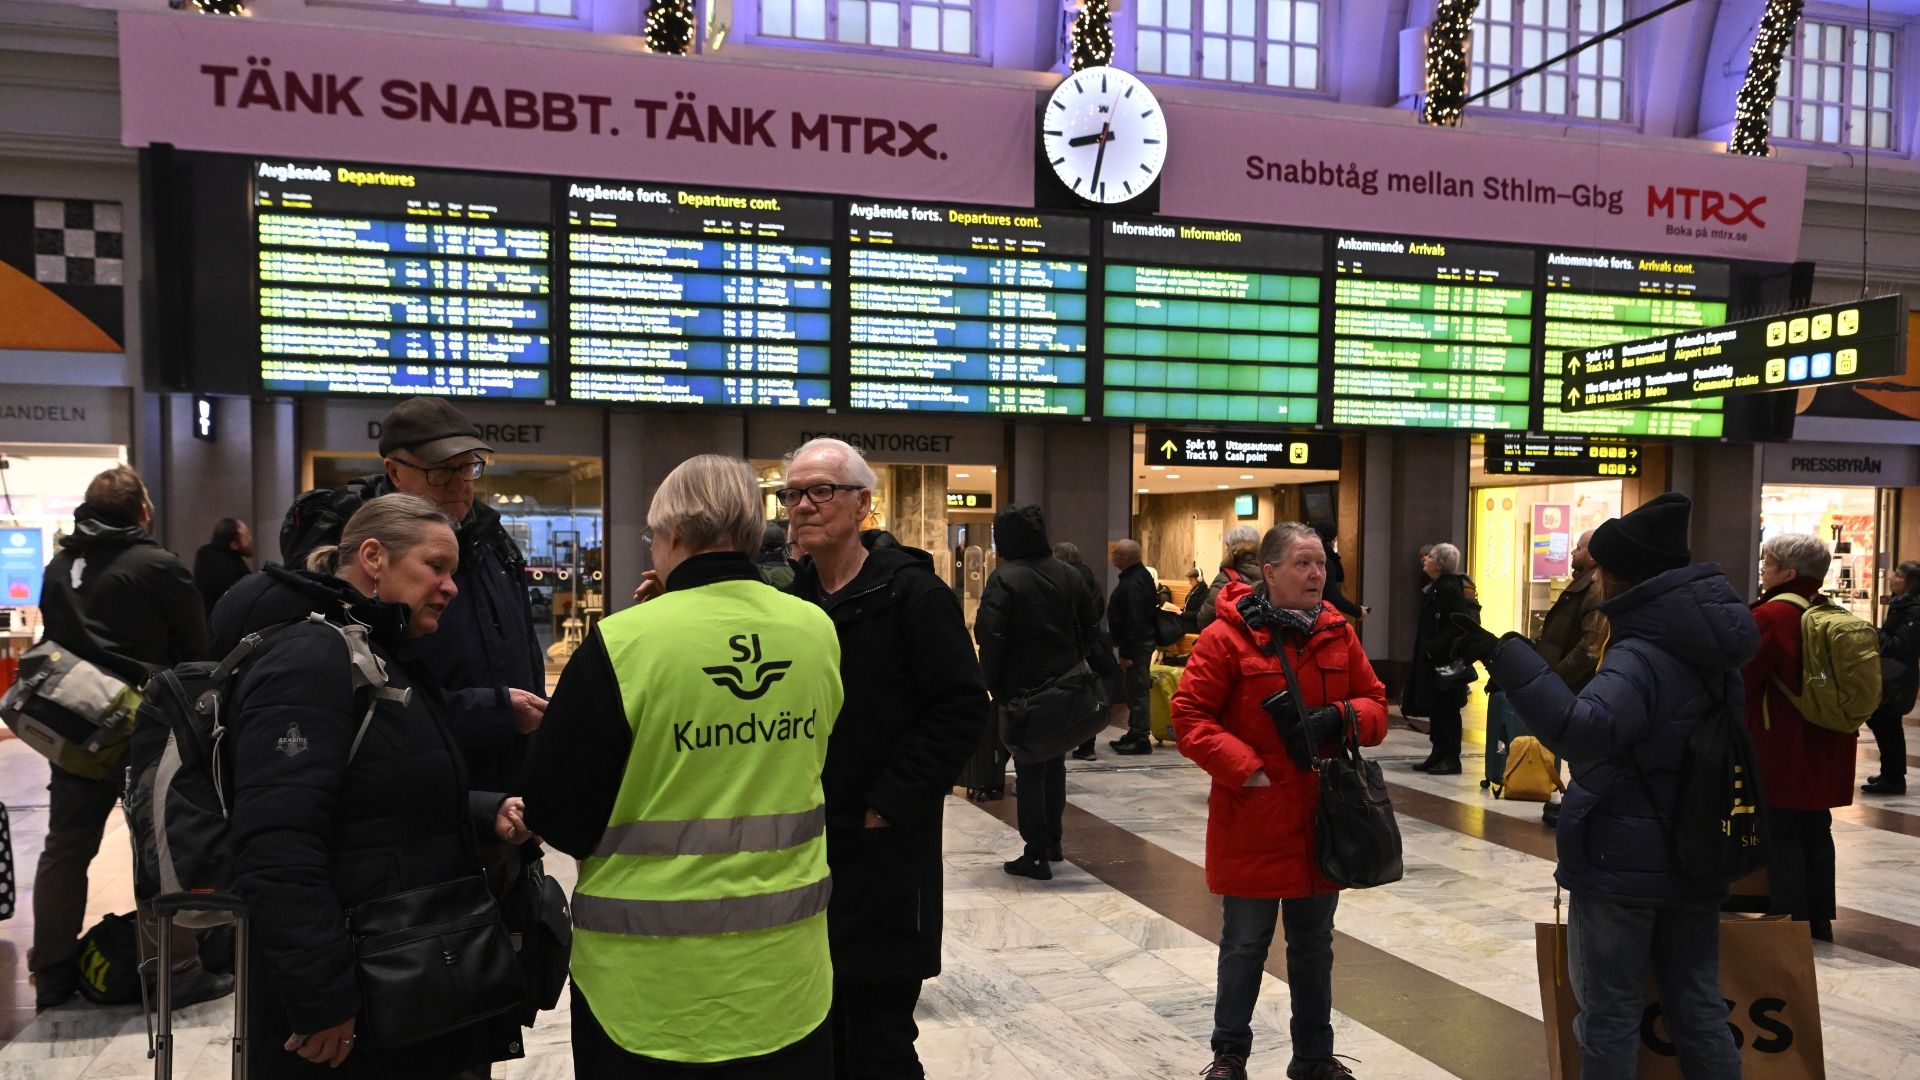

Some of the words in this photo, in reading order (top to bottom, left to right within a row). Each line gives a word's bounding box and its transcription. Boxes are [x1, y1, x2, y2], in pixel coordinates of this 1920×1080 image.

[201, 56, 363, 116] TÄNK
[381, 80, 619, 136] SNABBT.
[635, 91, 776, 147] TÄNK
[792, 112, 947, 160] MTRX.
[259, 163, 331, 181] Avgående
[338, 168, 415, 186] Departures
[1247, 156, 1378, 195] Snabbtåg
[1388, 171, 1473, 197] mellan
[569, 184, 634, 201] Avgående
[637, 188, 671, 203] forts.
[678, 191, 747, 208] Departures
[750, 199, 780, 210] cont.
[850, 204, 908, 220] Avgående
[911, 207, 942, 221] forts.
[949, 210, 1011, 225] Departures
[1014, 217, 1041, 227] cont.
[1647, 185, 1767, 228] MTRX
[1113, 222, 1175, 237] Information
[1181, 227, 1241, 242] Information
[1667, 225, 1691, 236] Boka
[1696, 228, 1707, 238] på
[1712, 230, 1747, 241] mtrx.se
[1338, 238, 1404, 253] Ankommande
[1409, 243, 1445, 256] Arrivals
[1548, 253, 1609, 268] Ankommande
[1611, 257, 1634, 269] forts.
[1639, 260, 1671, 272] Arrivals
[1673, 264, 1694, 273] cont.
[1635, 351, 1665, 365] terminal
[1675, 345, 1702, 361] Airport
[1702, 343, 1721, 356] train
[1646, 387, 1667, 397] Metro
[1693, 377, 1734, 391] Commuter
[1735, 375, 1759, 386] trains
[1606, 391, 1623, 401] track
[1186, 439, 1205, 451] Spår
[1207, 440, 1216, 449] 10
[1226, 441, 1282, 454] Uttagsautomat
[1186, 450, 1207, 460] Track
[1209, 451, 1218, 460] 10
[1225, 451, 1245, 460] Cash
[1246, 452, 1267, 463] point
[1791, 457, 1882, 474] PRESSBYRÅN
[729, 634, 762, 663] SJ
[674, 709, 816, 752] Kundvärd
